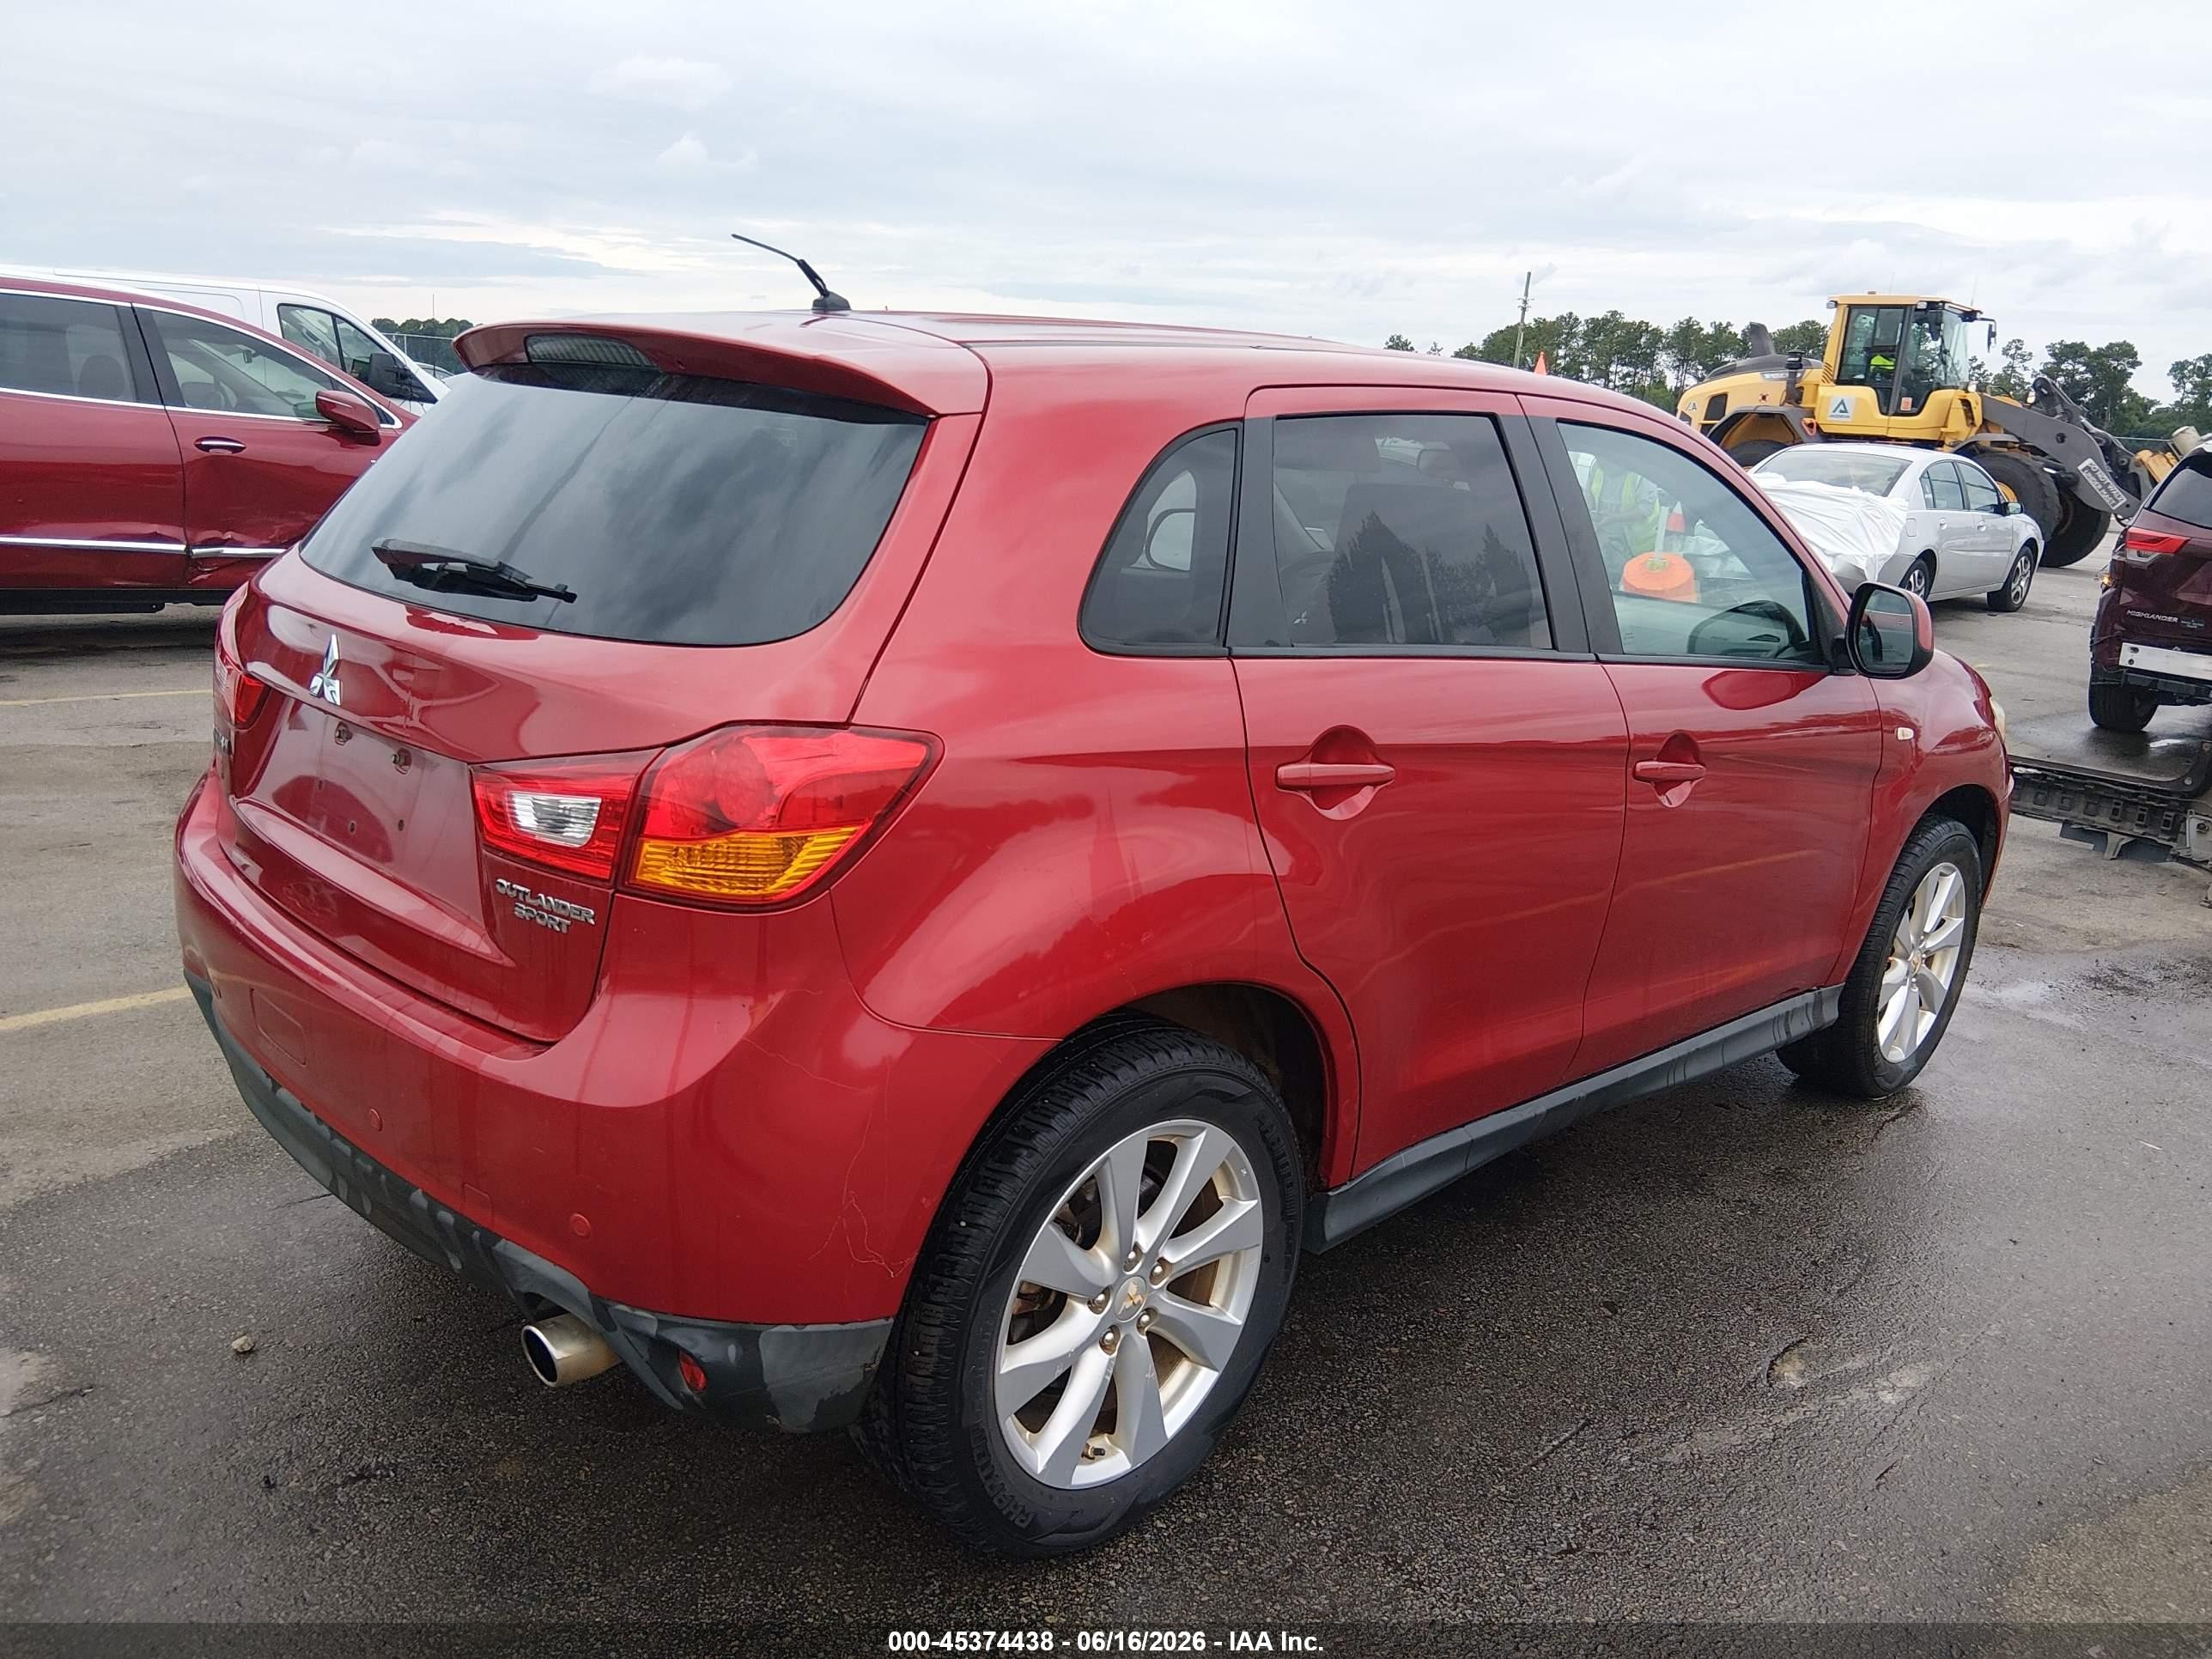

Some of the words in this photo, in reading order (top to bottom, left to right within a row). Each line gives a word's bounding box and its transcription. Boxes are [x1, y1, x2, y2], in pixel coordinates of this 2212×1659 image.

[2127, 610, 2178, 623] HIGHLANDER
[495, 878, 595, 925] OUTLANDER
[514, 902, 571, 933] SPORT
